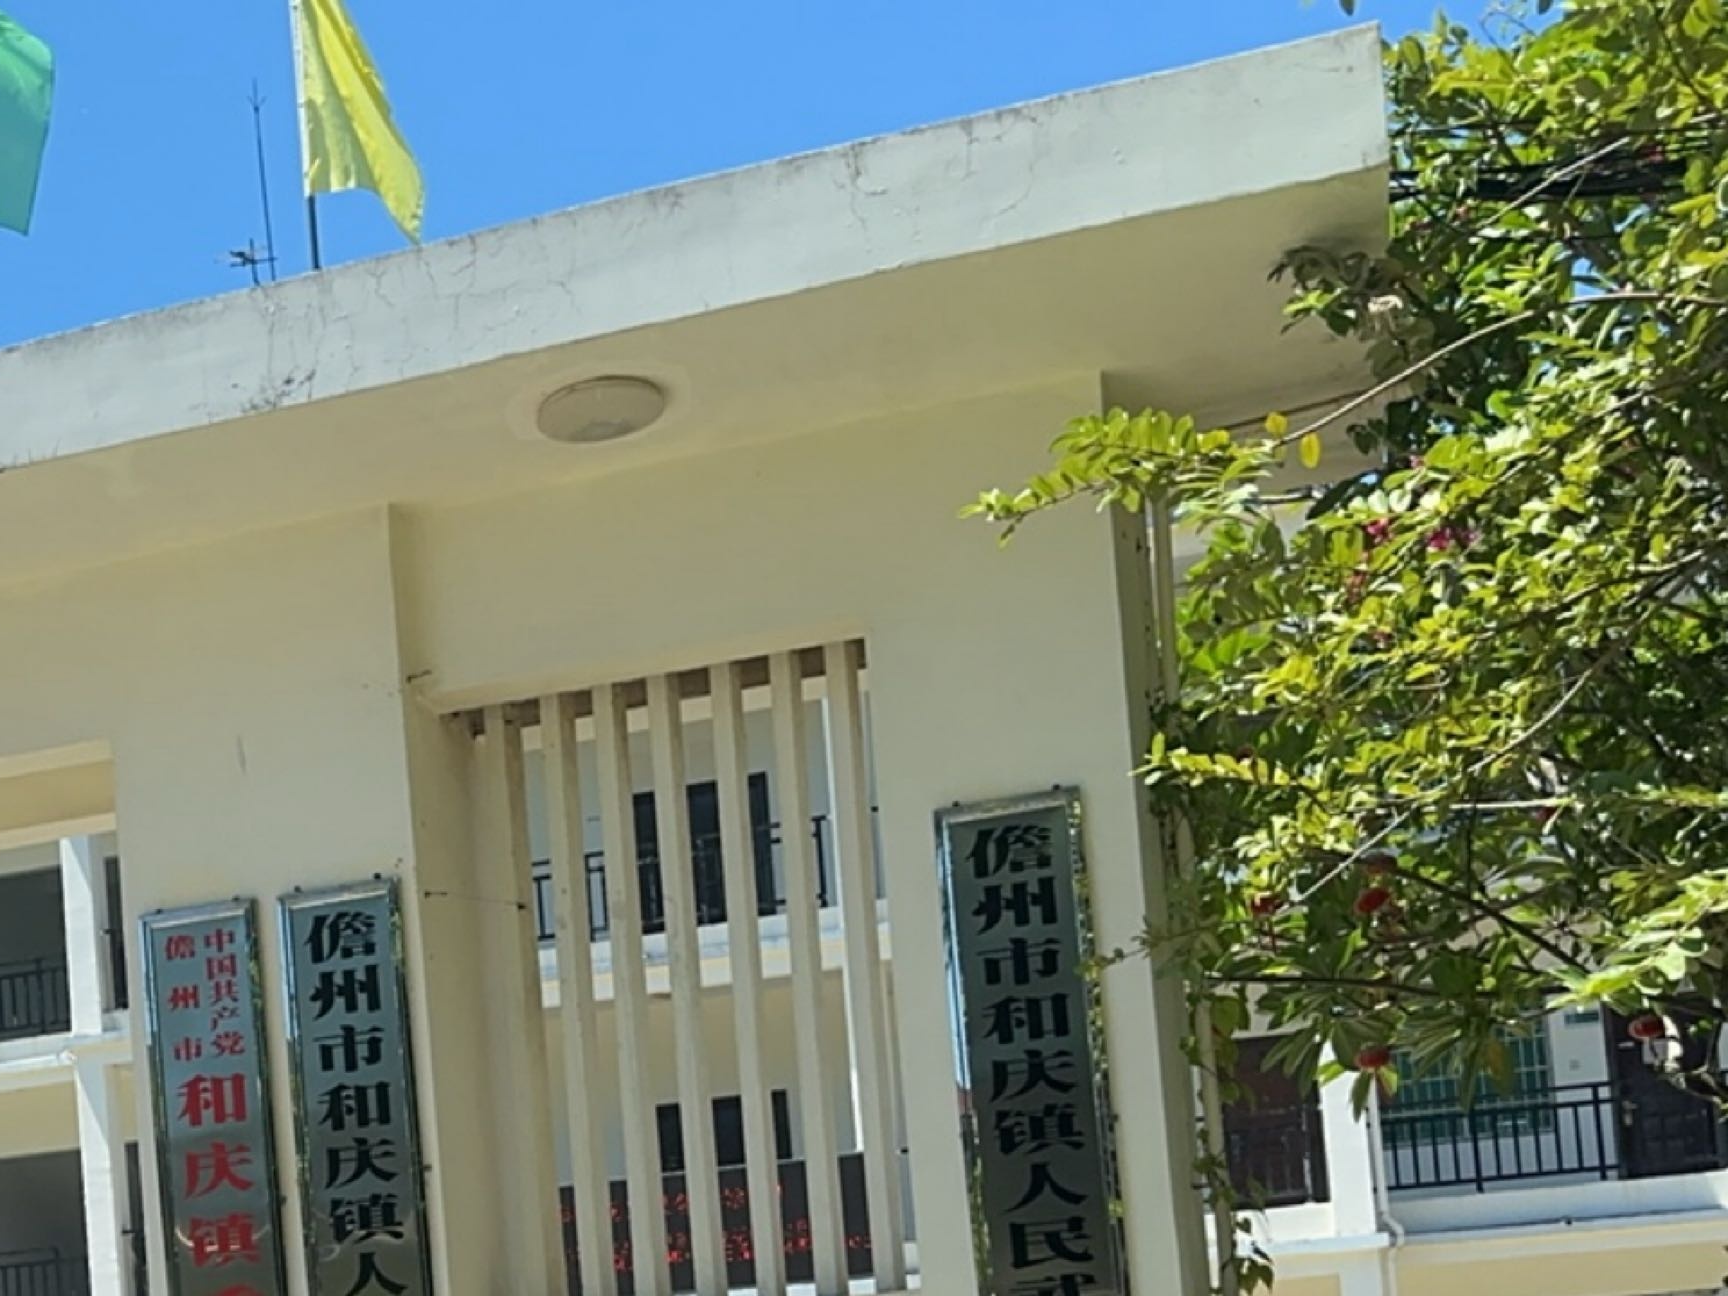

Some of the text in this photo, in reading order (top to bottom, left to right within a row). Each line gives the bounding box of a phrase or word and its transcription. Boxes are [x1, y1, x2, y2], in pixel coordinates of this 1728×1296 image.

[165, 934, 202, 1061] 儋州市
[204, 928, 246, 1057] 中国共产党
